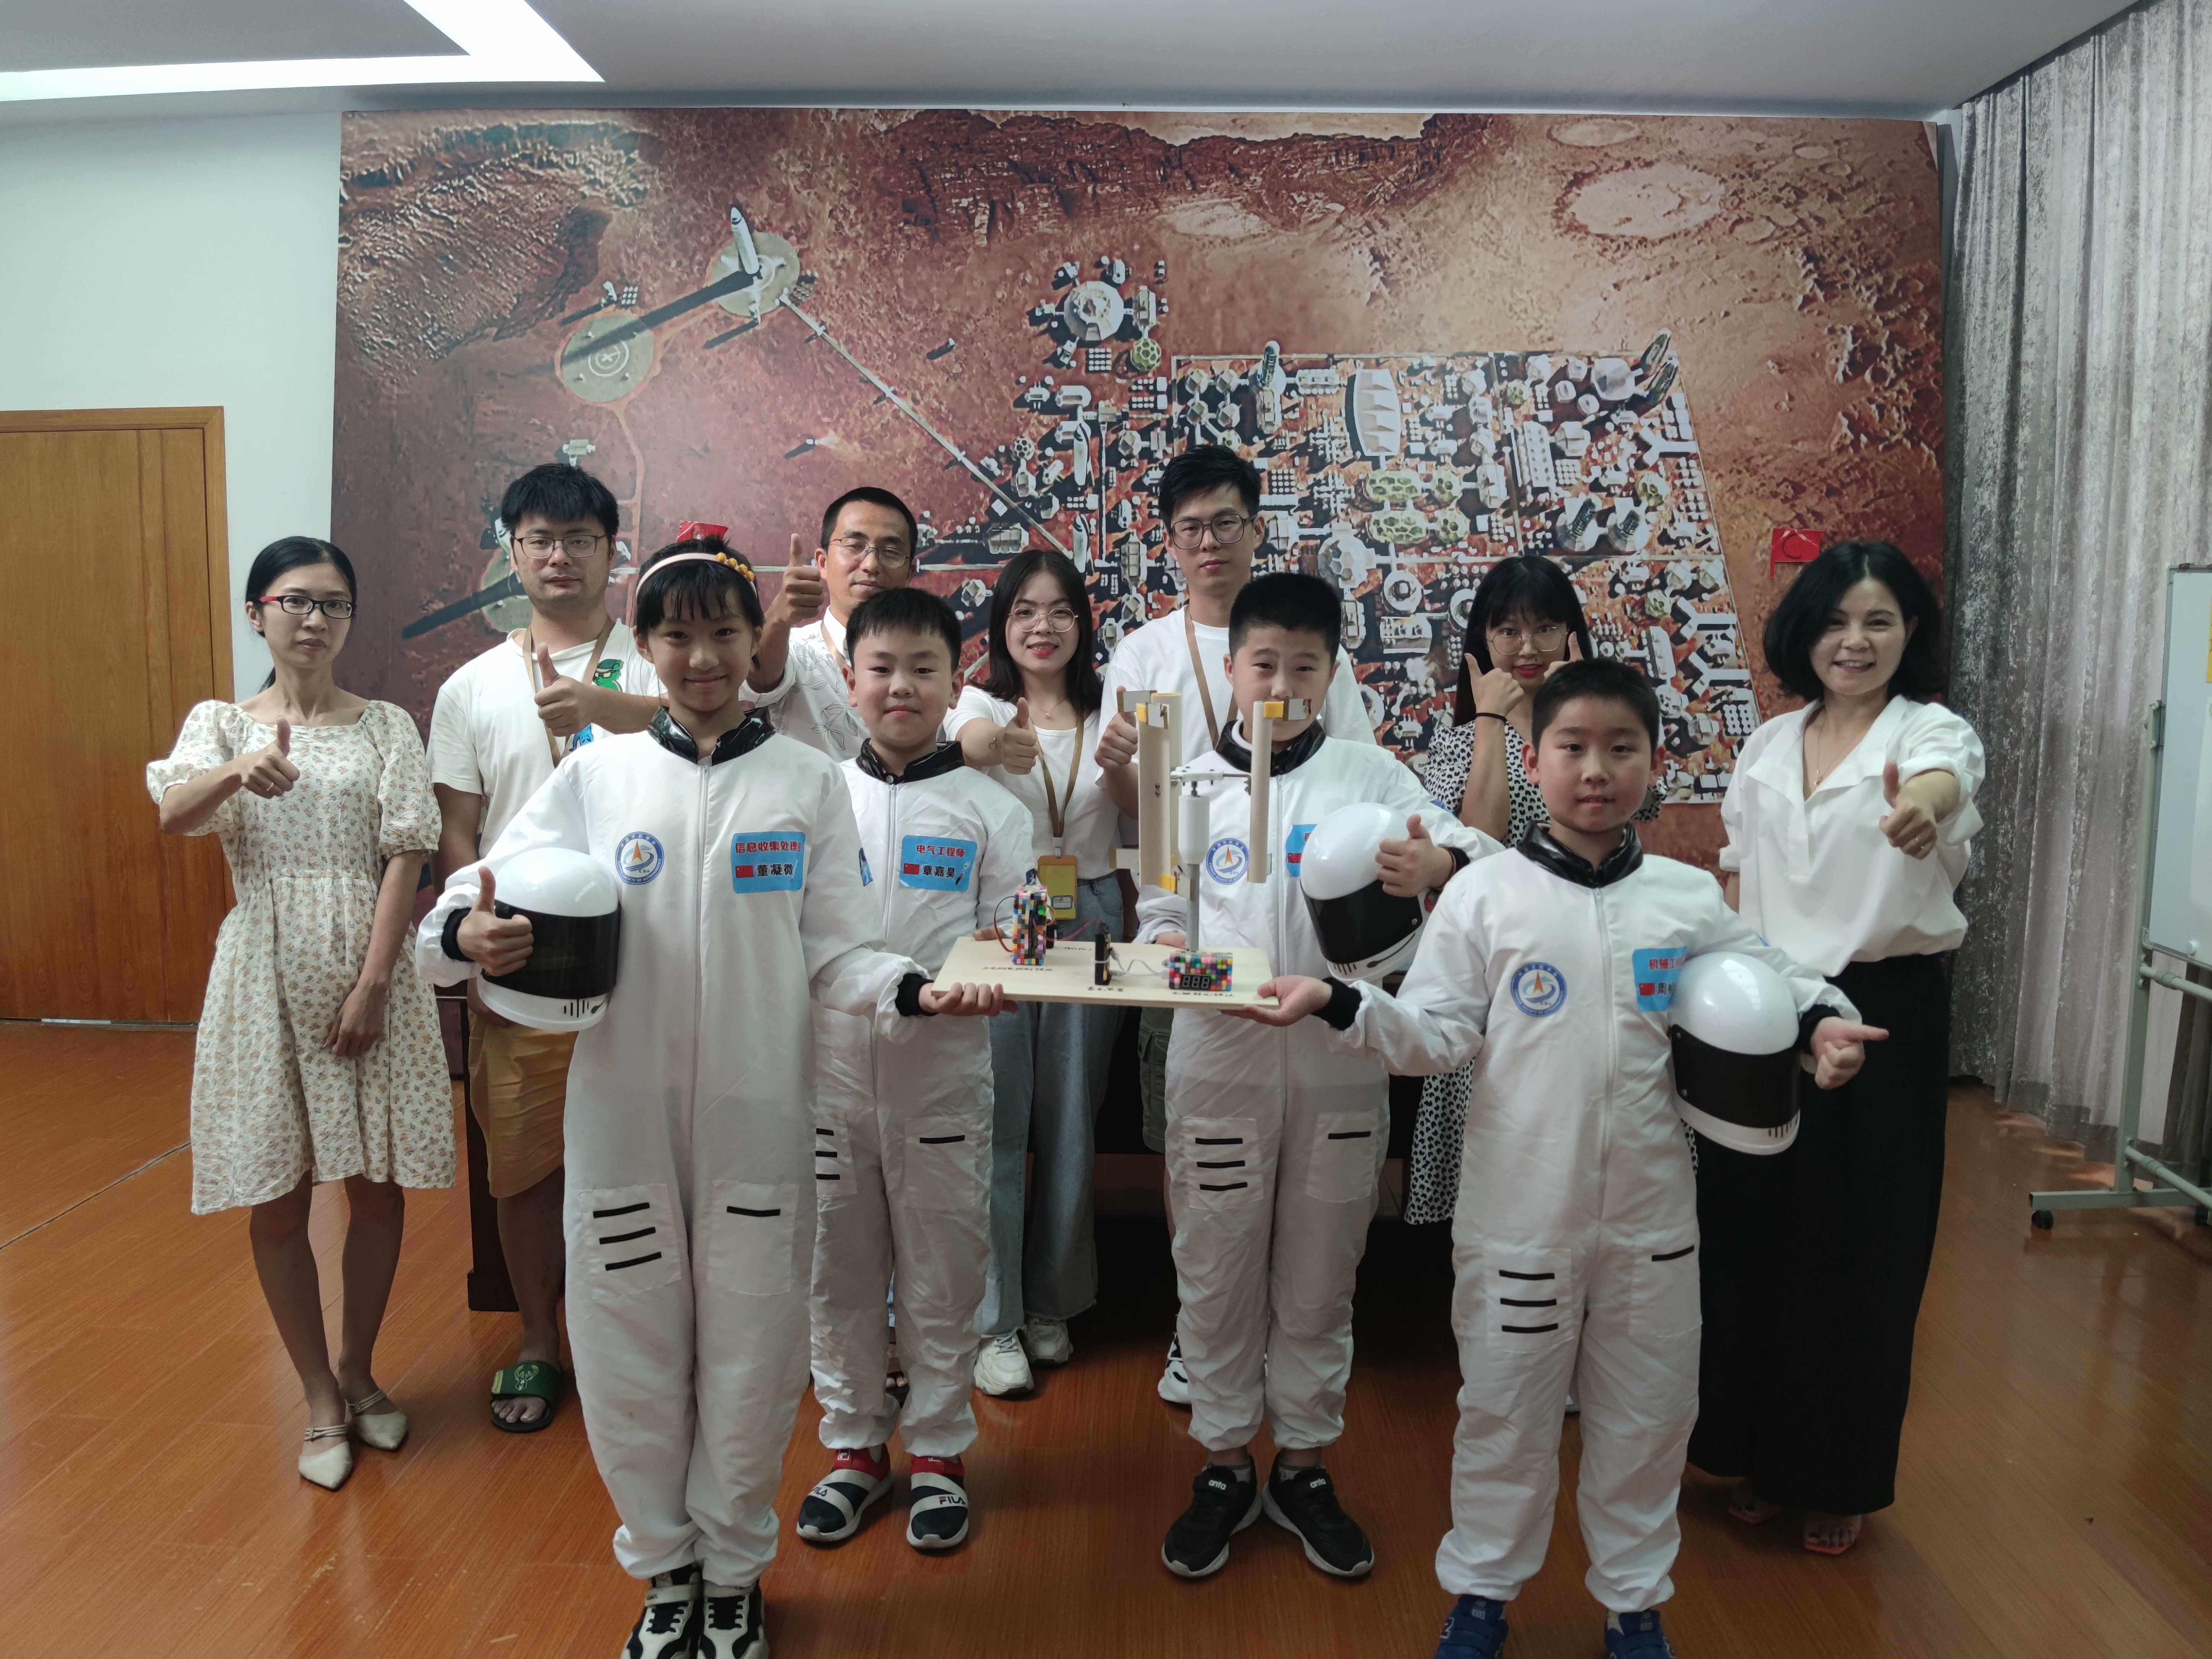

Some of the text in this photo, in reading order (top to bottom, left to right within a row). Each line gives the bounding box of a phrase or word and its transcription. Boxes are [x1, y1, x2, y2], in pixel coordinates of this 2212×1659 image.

[917, 844, 965, 858] 电气工程师
[1208, 1480, 1226, 1491] anta
[1310, 1478, 1326, 1488] anta
[938, 1496, 966, 1505] FILA
